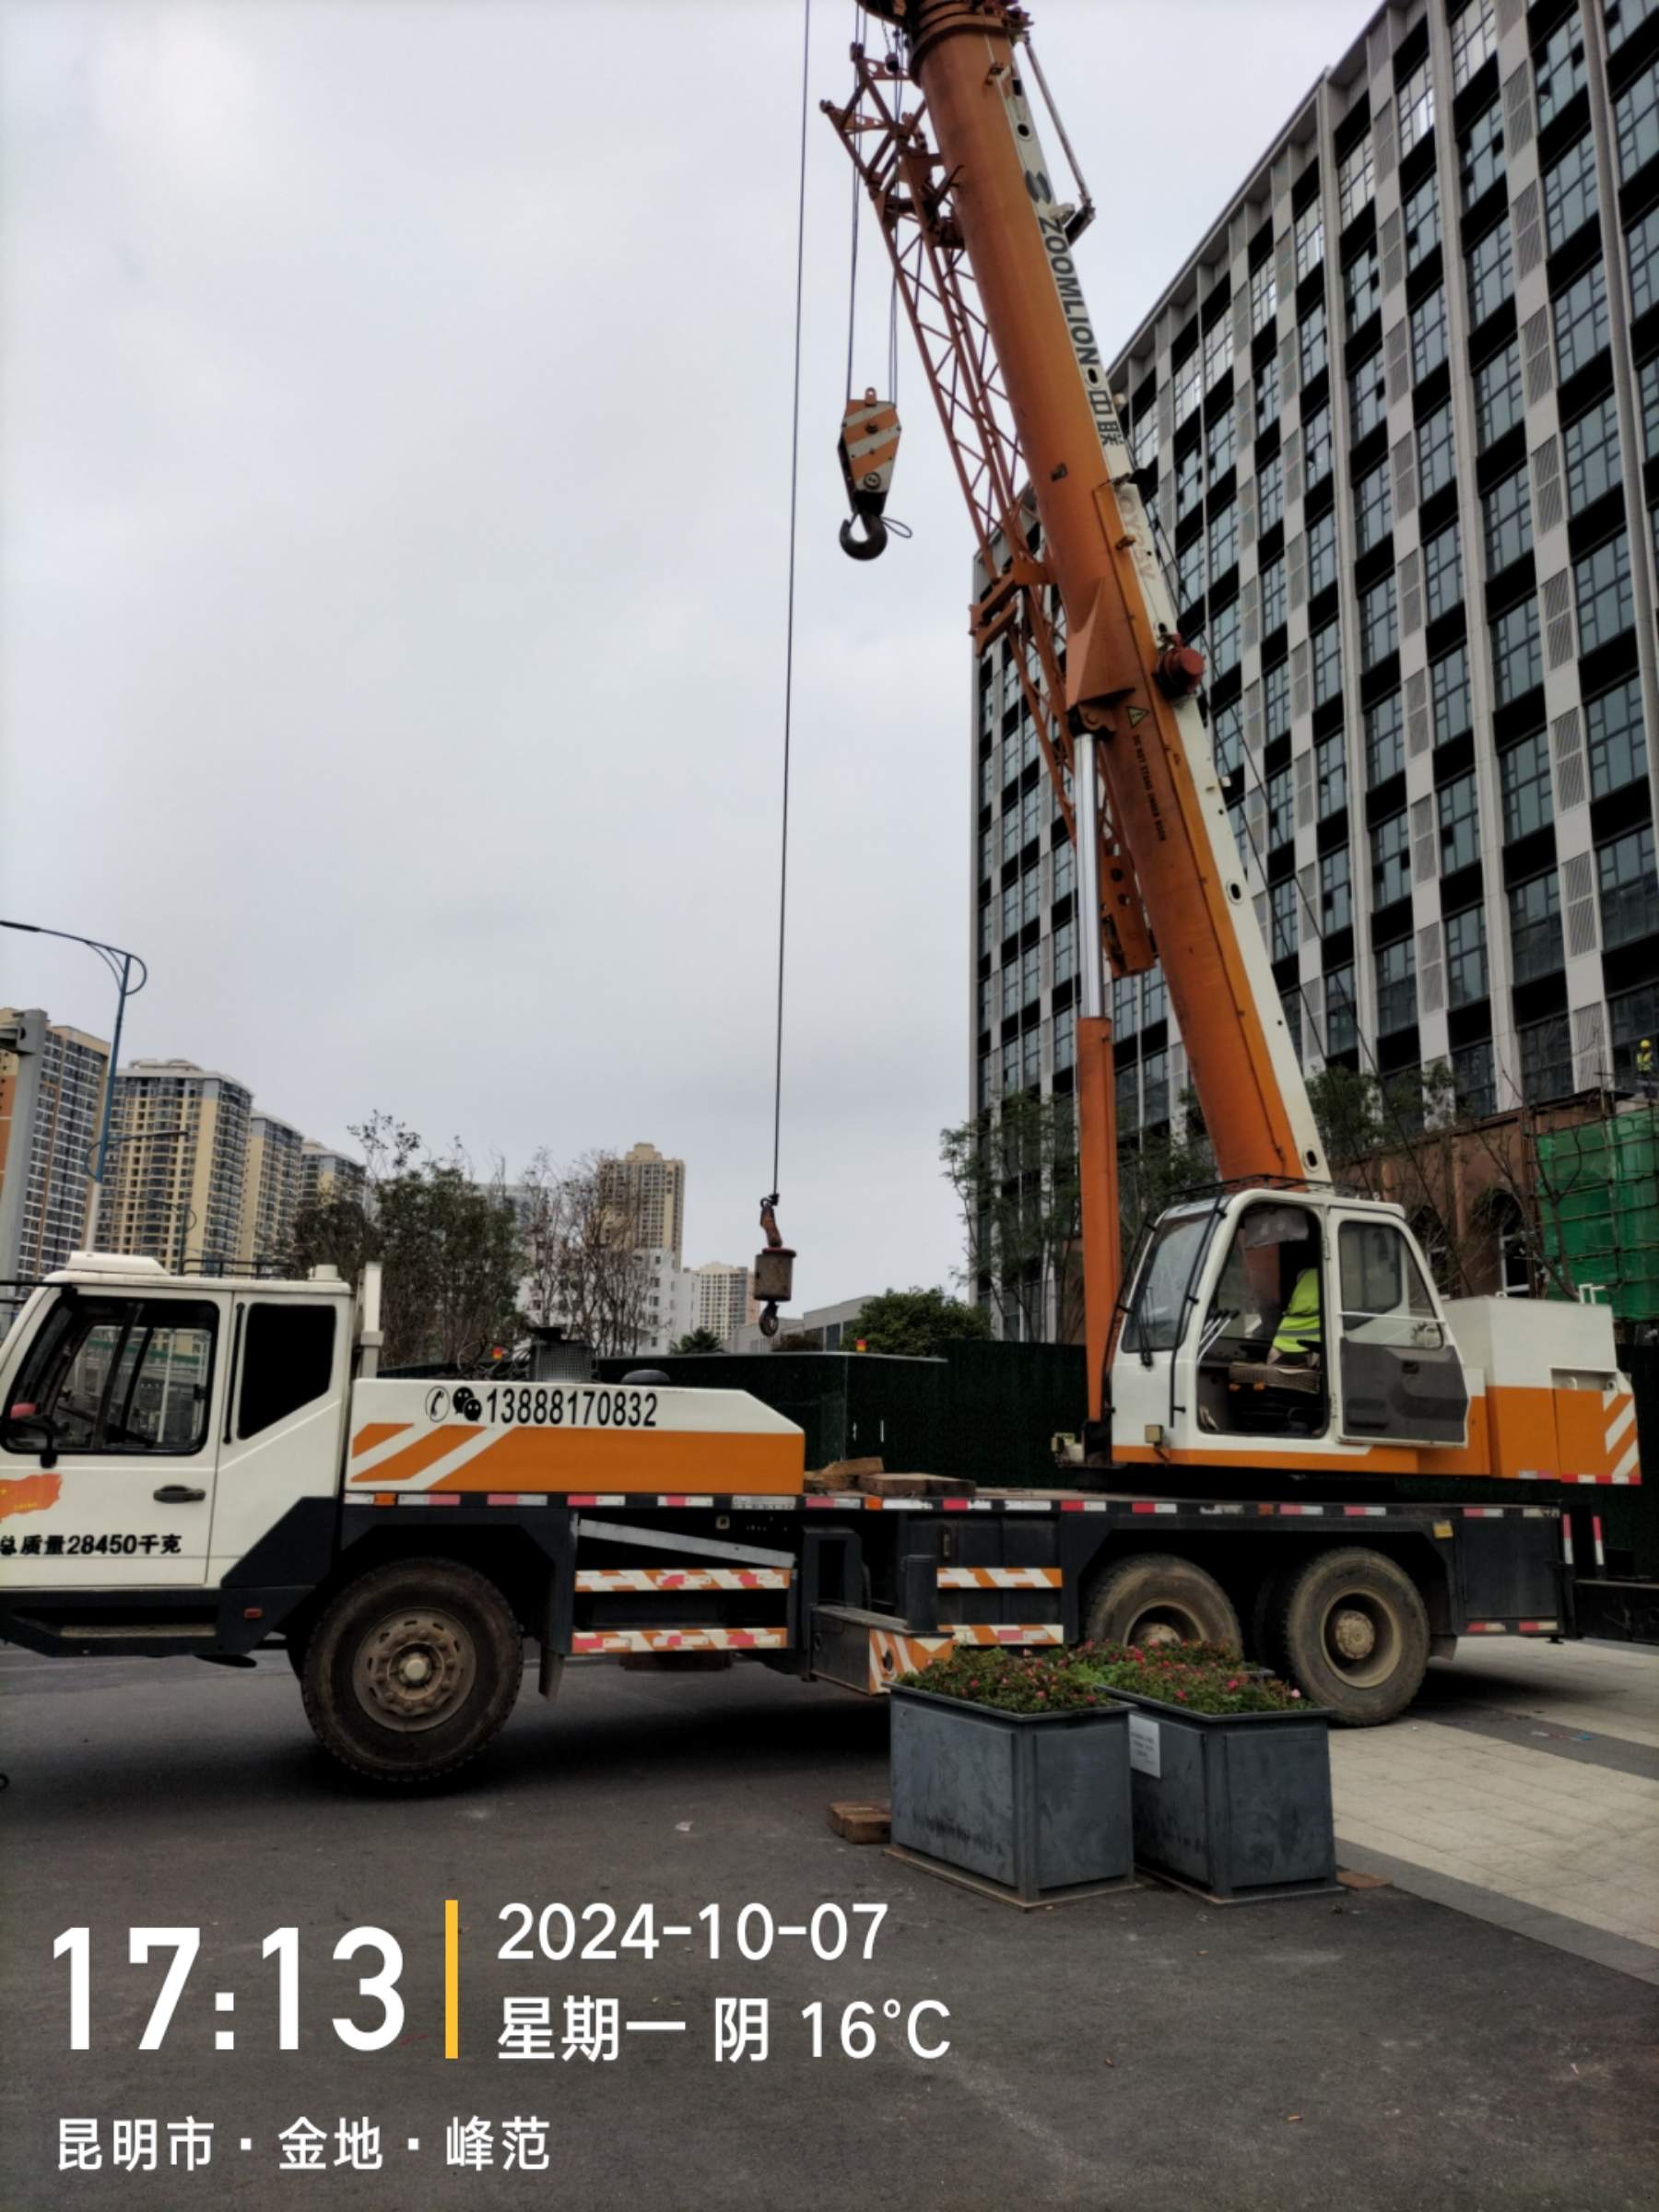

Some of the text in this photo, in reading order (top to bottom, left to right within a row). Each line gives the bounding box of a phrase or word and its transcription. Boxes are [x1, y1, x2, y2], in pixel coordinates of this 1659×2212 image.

[1038, 216, 1124, 445] ZOOMLION 中联
[486, 1387, 658, 1427] 13888170832
[0, 1534, 182, 1556] 总质量28450千克
